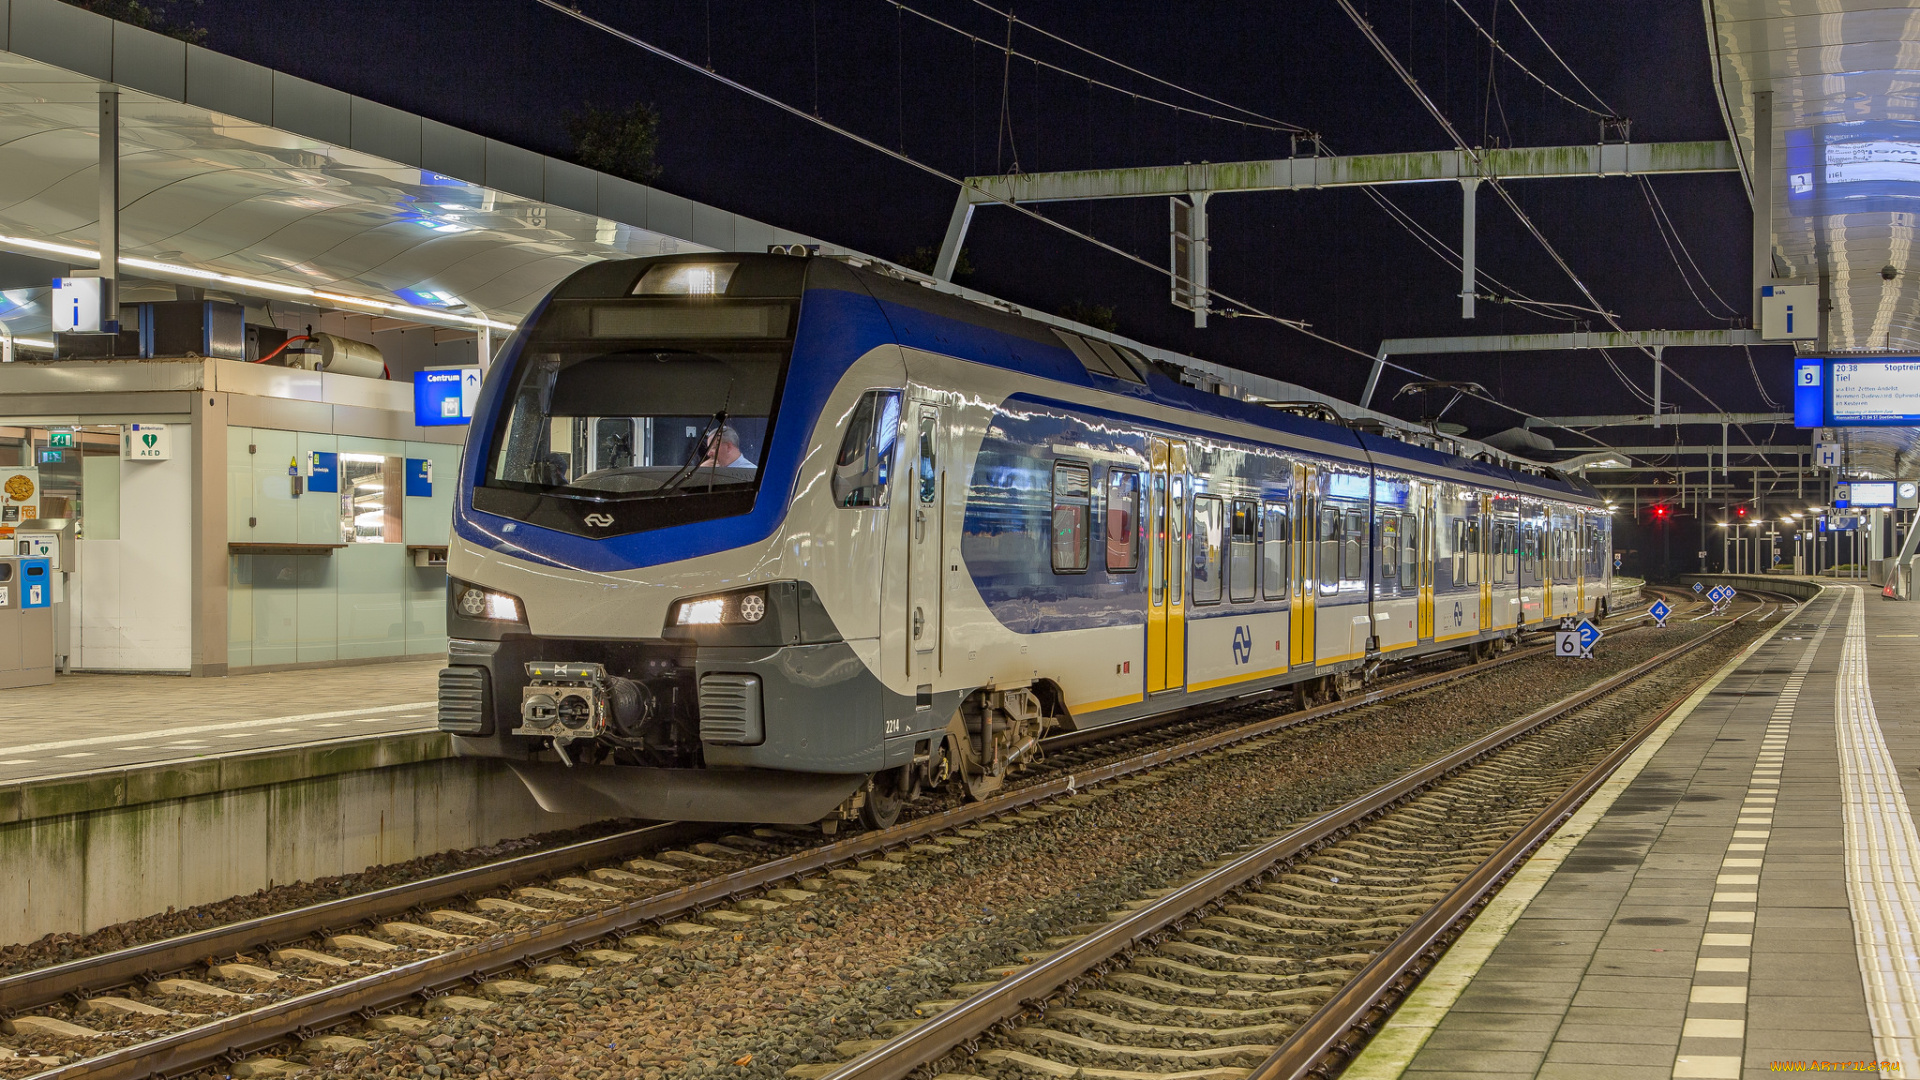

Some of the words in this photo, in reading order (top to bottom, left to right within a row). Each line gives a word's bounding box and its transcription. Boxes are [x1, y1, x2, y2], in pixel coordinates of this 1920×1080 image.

[1836, 364, 1858, 372] 20:38
[427, 374, 460, 382] Centrum
[1804, 373, 1813, 384] 9
[1835, 374, 1851, 382] Tiel
[1823, 452, 1834, 464] H
[1838, 491, 1846, 499] G
[1712, 591, 1719, 599] 6
[1655, 606, 1664, 615] 4
[1581, 628, 1591, 641] 2
[1561, 634, 1574, 653] 6
[885, 718, 900, 734] 2214
